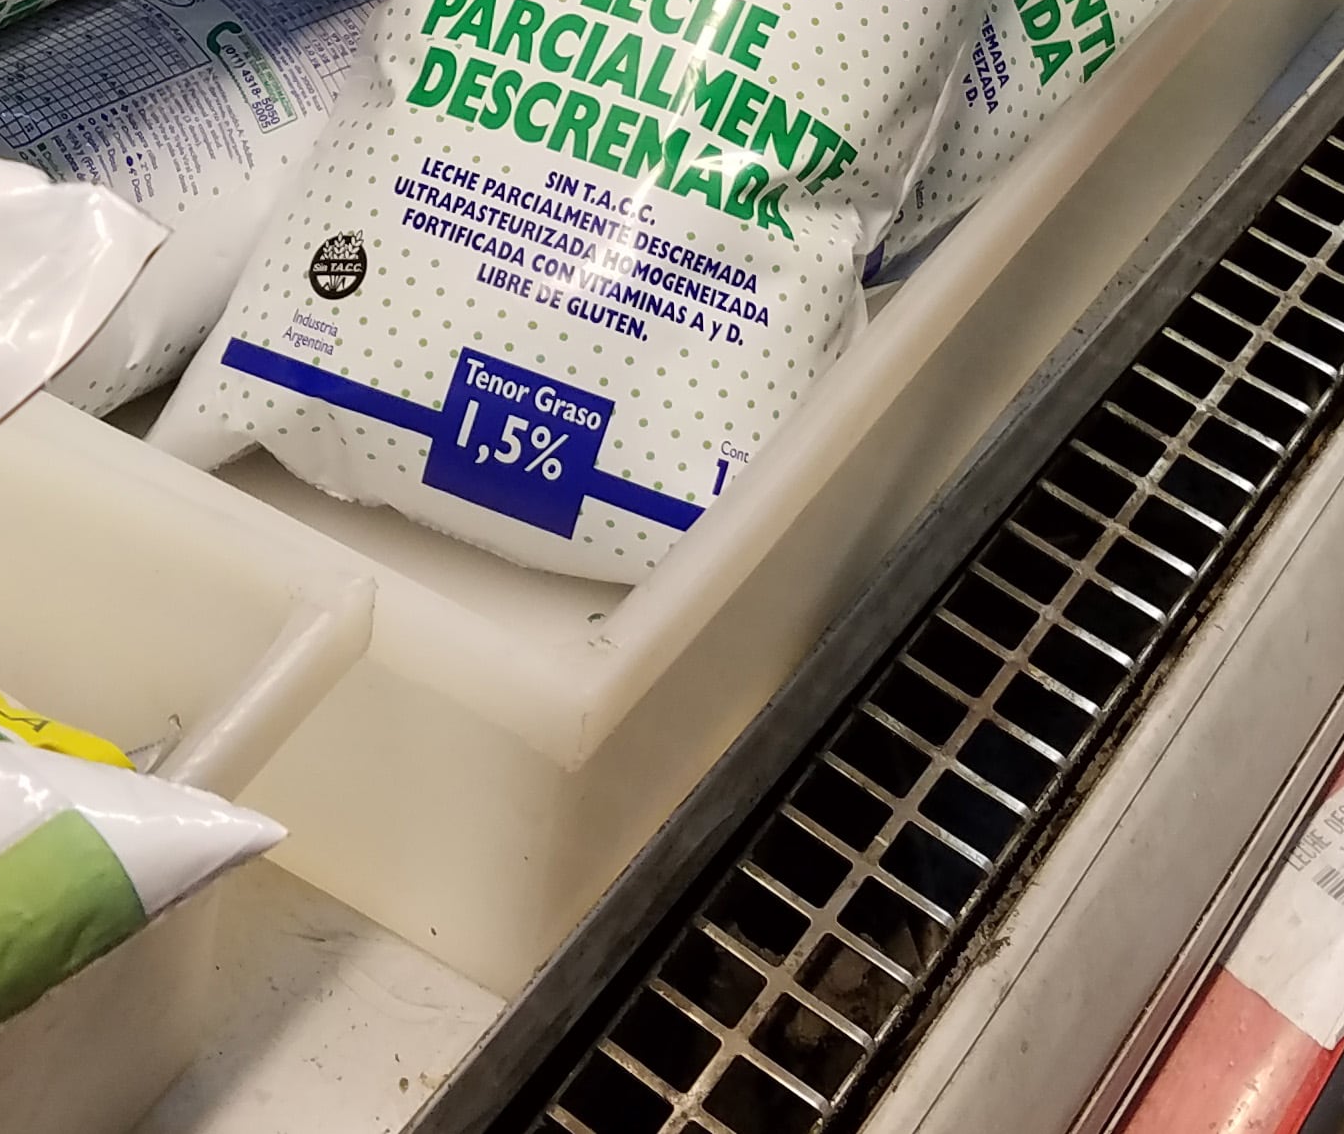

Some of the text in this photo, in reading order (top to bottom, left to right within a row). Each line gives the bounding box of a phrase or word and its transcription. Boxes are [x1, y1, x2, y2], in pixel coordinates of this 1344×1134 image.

[250, 100, 272, 129] 5005
[259, 96, 283, 126] 5050
[406, 46, 796, 241] DESCREMADA
[419, 156, 759, 294] LECHE PARCIALMENTE DESCREMADA
[544, 171, 656, 226] SIN T.A.C.C.
[392, 176, 770, 327] ULTRAPASTEURIZADA HOMOGENEIZADA
[401, 208, 526, 267] FORTIFICADA
[531, 251, 577, 287] CON
[577, 260, 687, 326] VITAMINAS
[687, 308, 706, 330] A
[725, 320, 746, 347] D.
[281, 324, 337, 358] Argentina
[291, 307, 340, 339] Industria
[476, 264, 650, 343] LIBRE DE GLUTEN.
[463, 358, 604, 432] Tenor Graso
[455, 398, 570, 483] 1,5%
